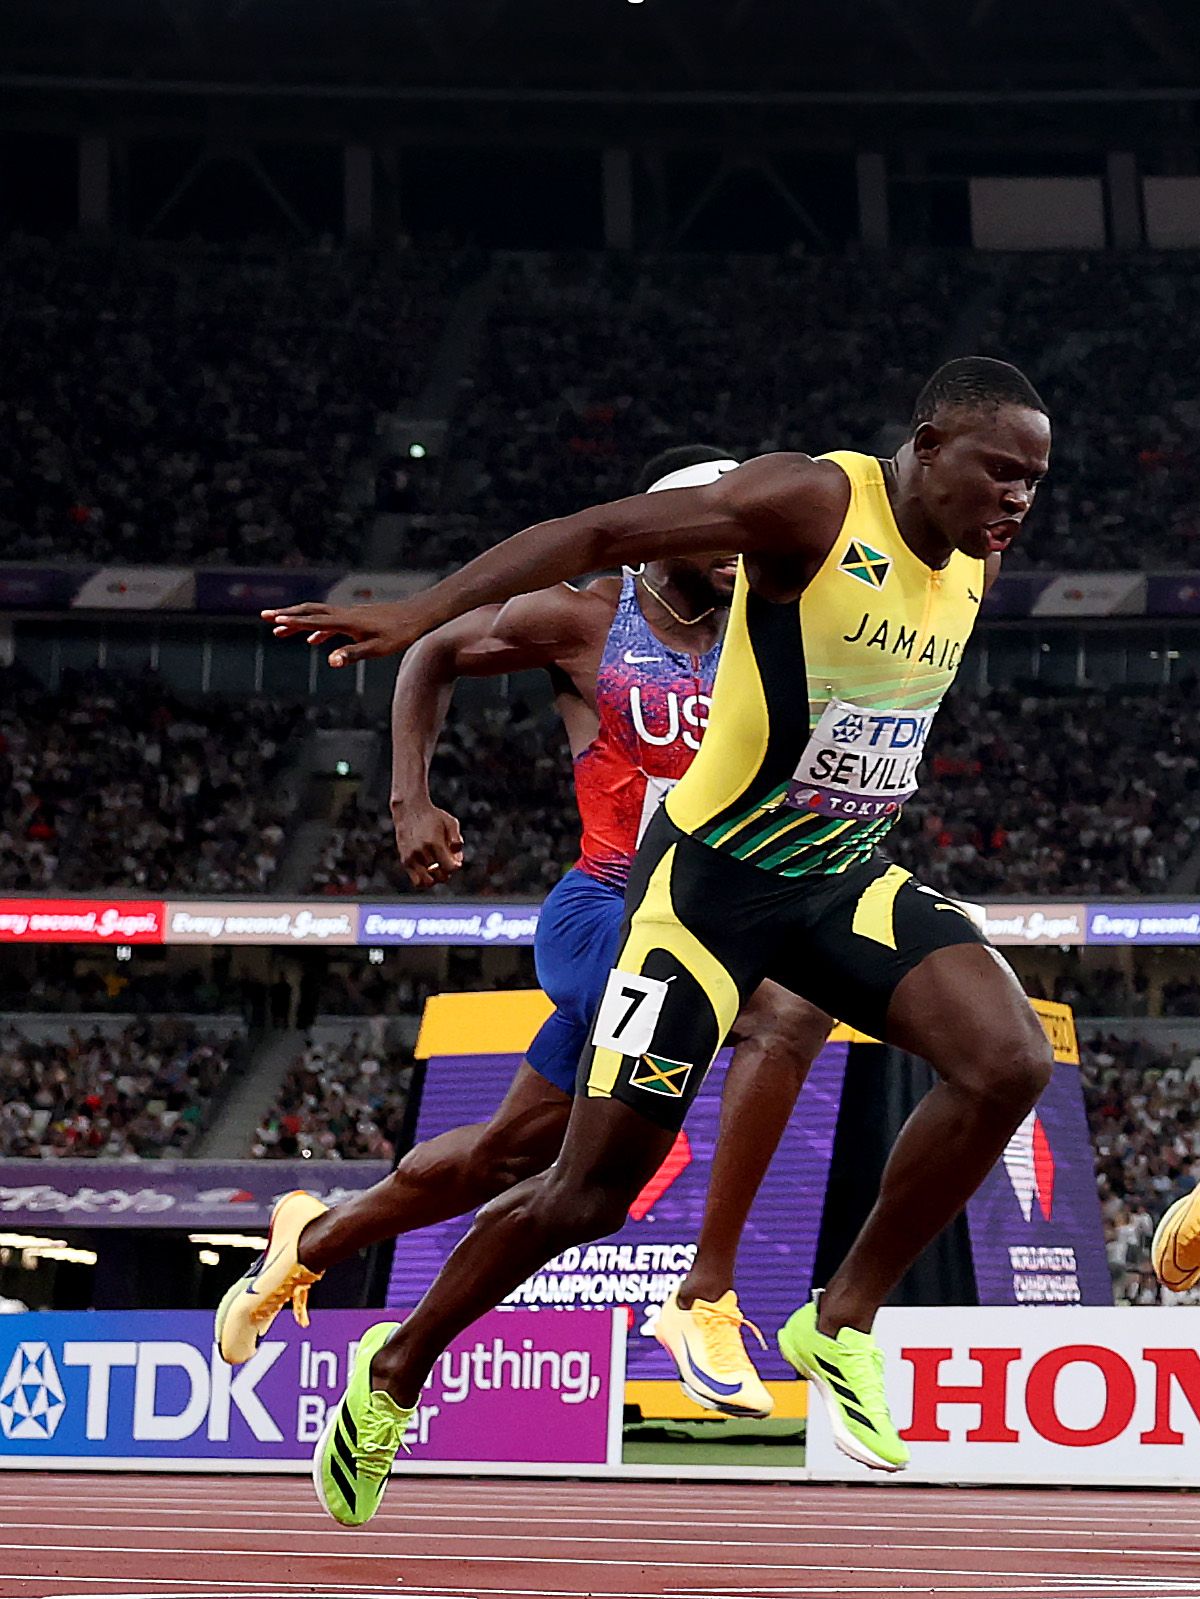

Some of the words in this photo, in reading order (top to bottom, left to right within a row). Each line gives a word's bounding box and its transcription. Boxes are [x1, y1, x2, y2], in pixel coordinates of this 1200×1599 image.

[843, 613, 962, 670] JAMAIC
[809, 749, 919, 790] SEVILL
[829, 797, 898, 816] TOKYO
[172, 913, 225, 937] Every
[365, 915, 417, 939] Every
[1091, 915, 1140, 938] Every
[612, 986, 649, 1039] 7
[580, 1244, 698, 1272] ATHLETICS
[500, 1273, 688, 1304] HAMPIONSHIP
[300, 1341, 338, 1388] In
[64, 1341, 287, 1442] TDK
